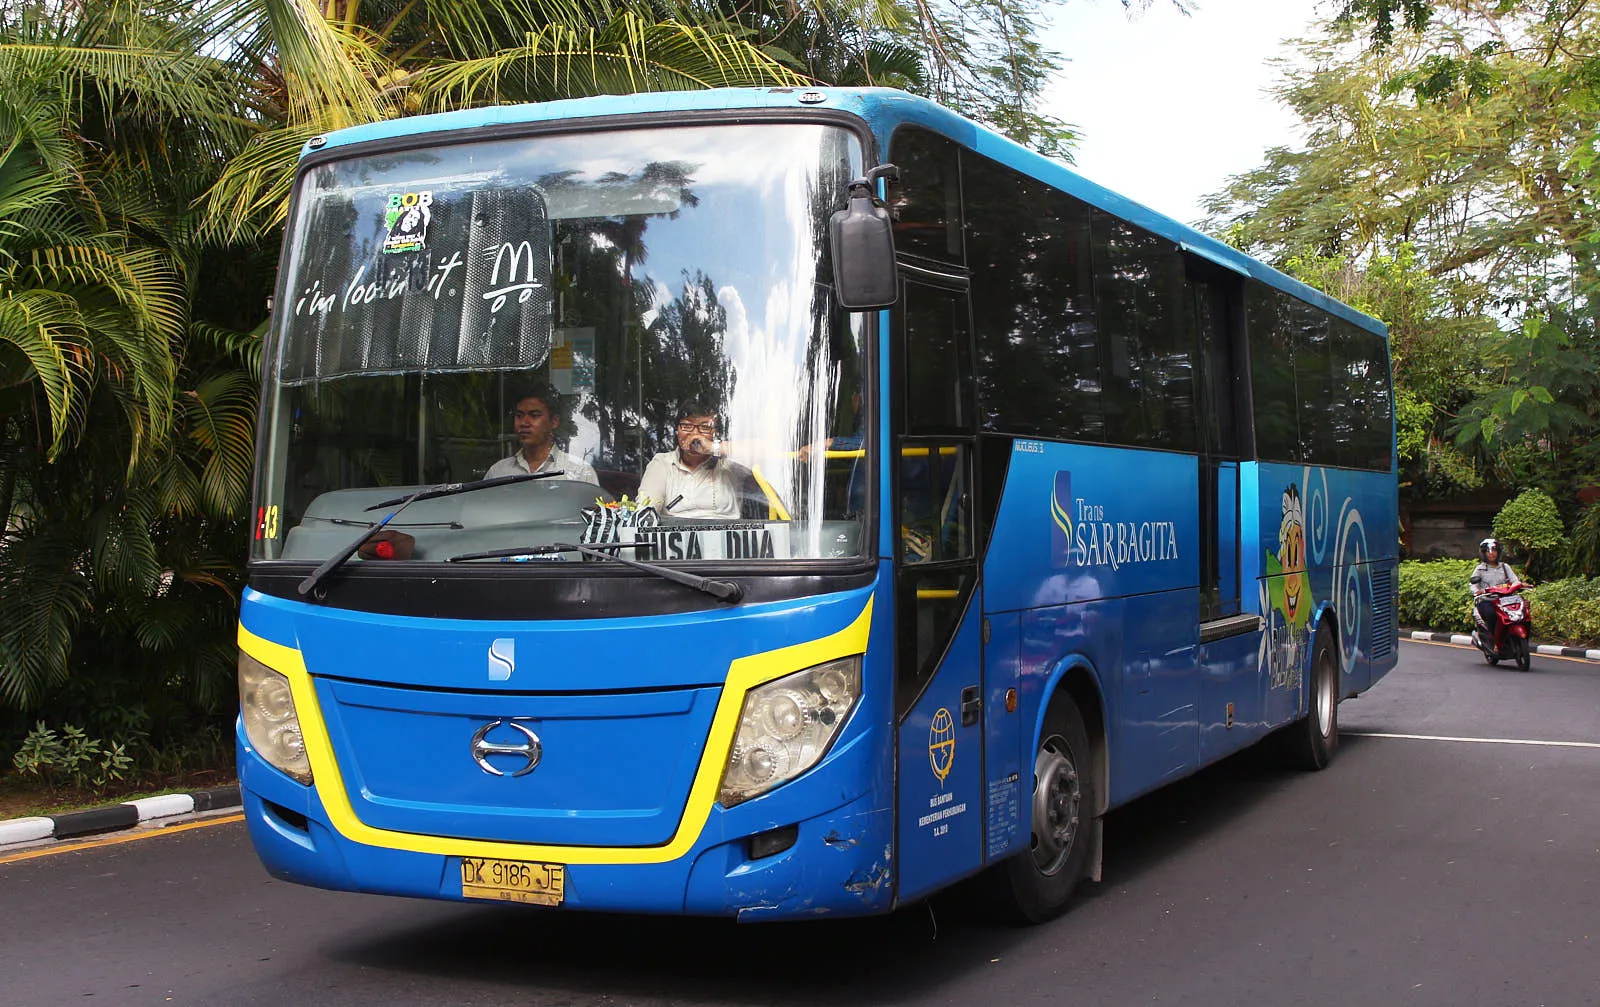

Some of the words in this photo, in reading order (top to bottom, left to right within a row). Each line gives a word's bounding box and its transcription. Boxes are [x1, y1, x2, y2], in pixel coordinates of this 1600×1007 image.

[387, 191, 433, 209] BOB
[296, 280, 336, 316] i'm
[1076, 498, 1104, 522] Trans
[635, 532, 702, 561] NUSA
[726, 530, 775, 559] DUA
[1076, 521, 1178, 571] SARBAGITA
[463, 860, 485, 884] DK
[492, 862, 531, 887] 9186
[536, 864, 562, 891] JE
